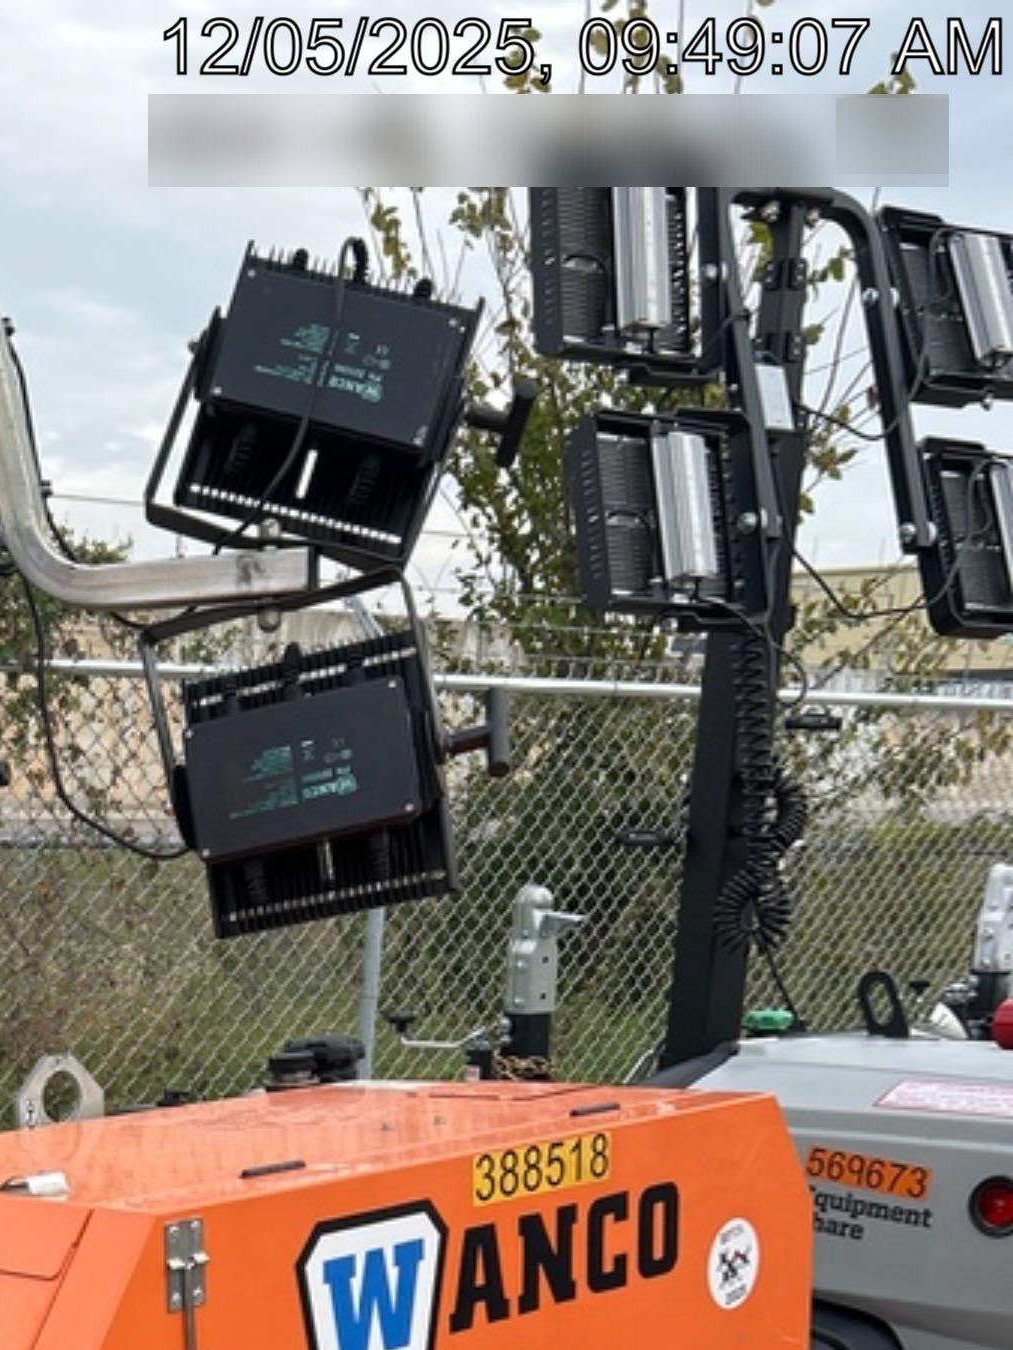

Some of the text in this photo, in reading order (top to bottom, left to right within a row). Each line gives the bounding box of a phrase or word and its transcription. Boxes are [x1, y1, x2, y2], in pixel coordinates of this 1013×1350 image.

[475, 1133, 609, 1201] 388518
[806, 1147, 928, 1198] 569673
[809, 1184, 933, 1229] quipment
[812, 1211, 865, 1240] hare
